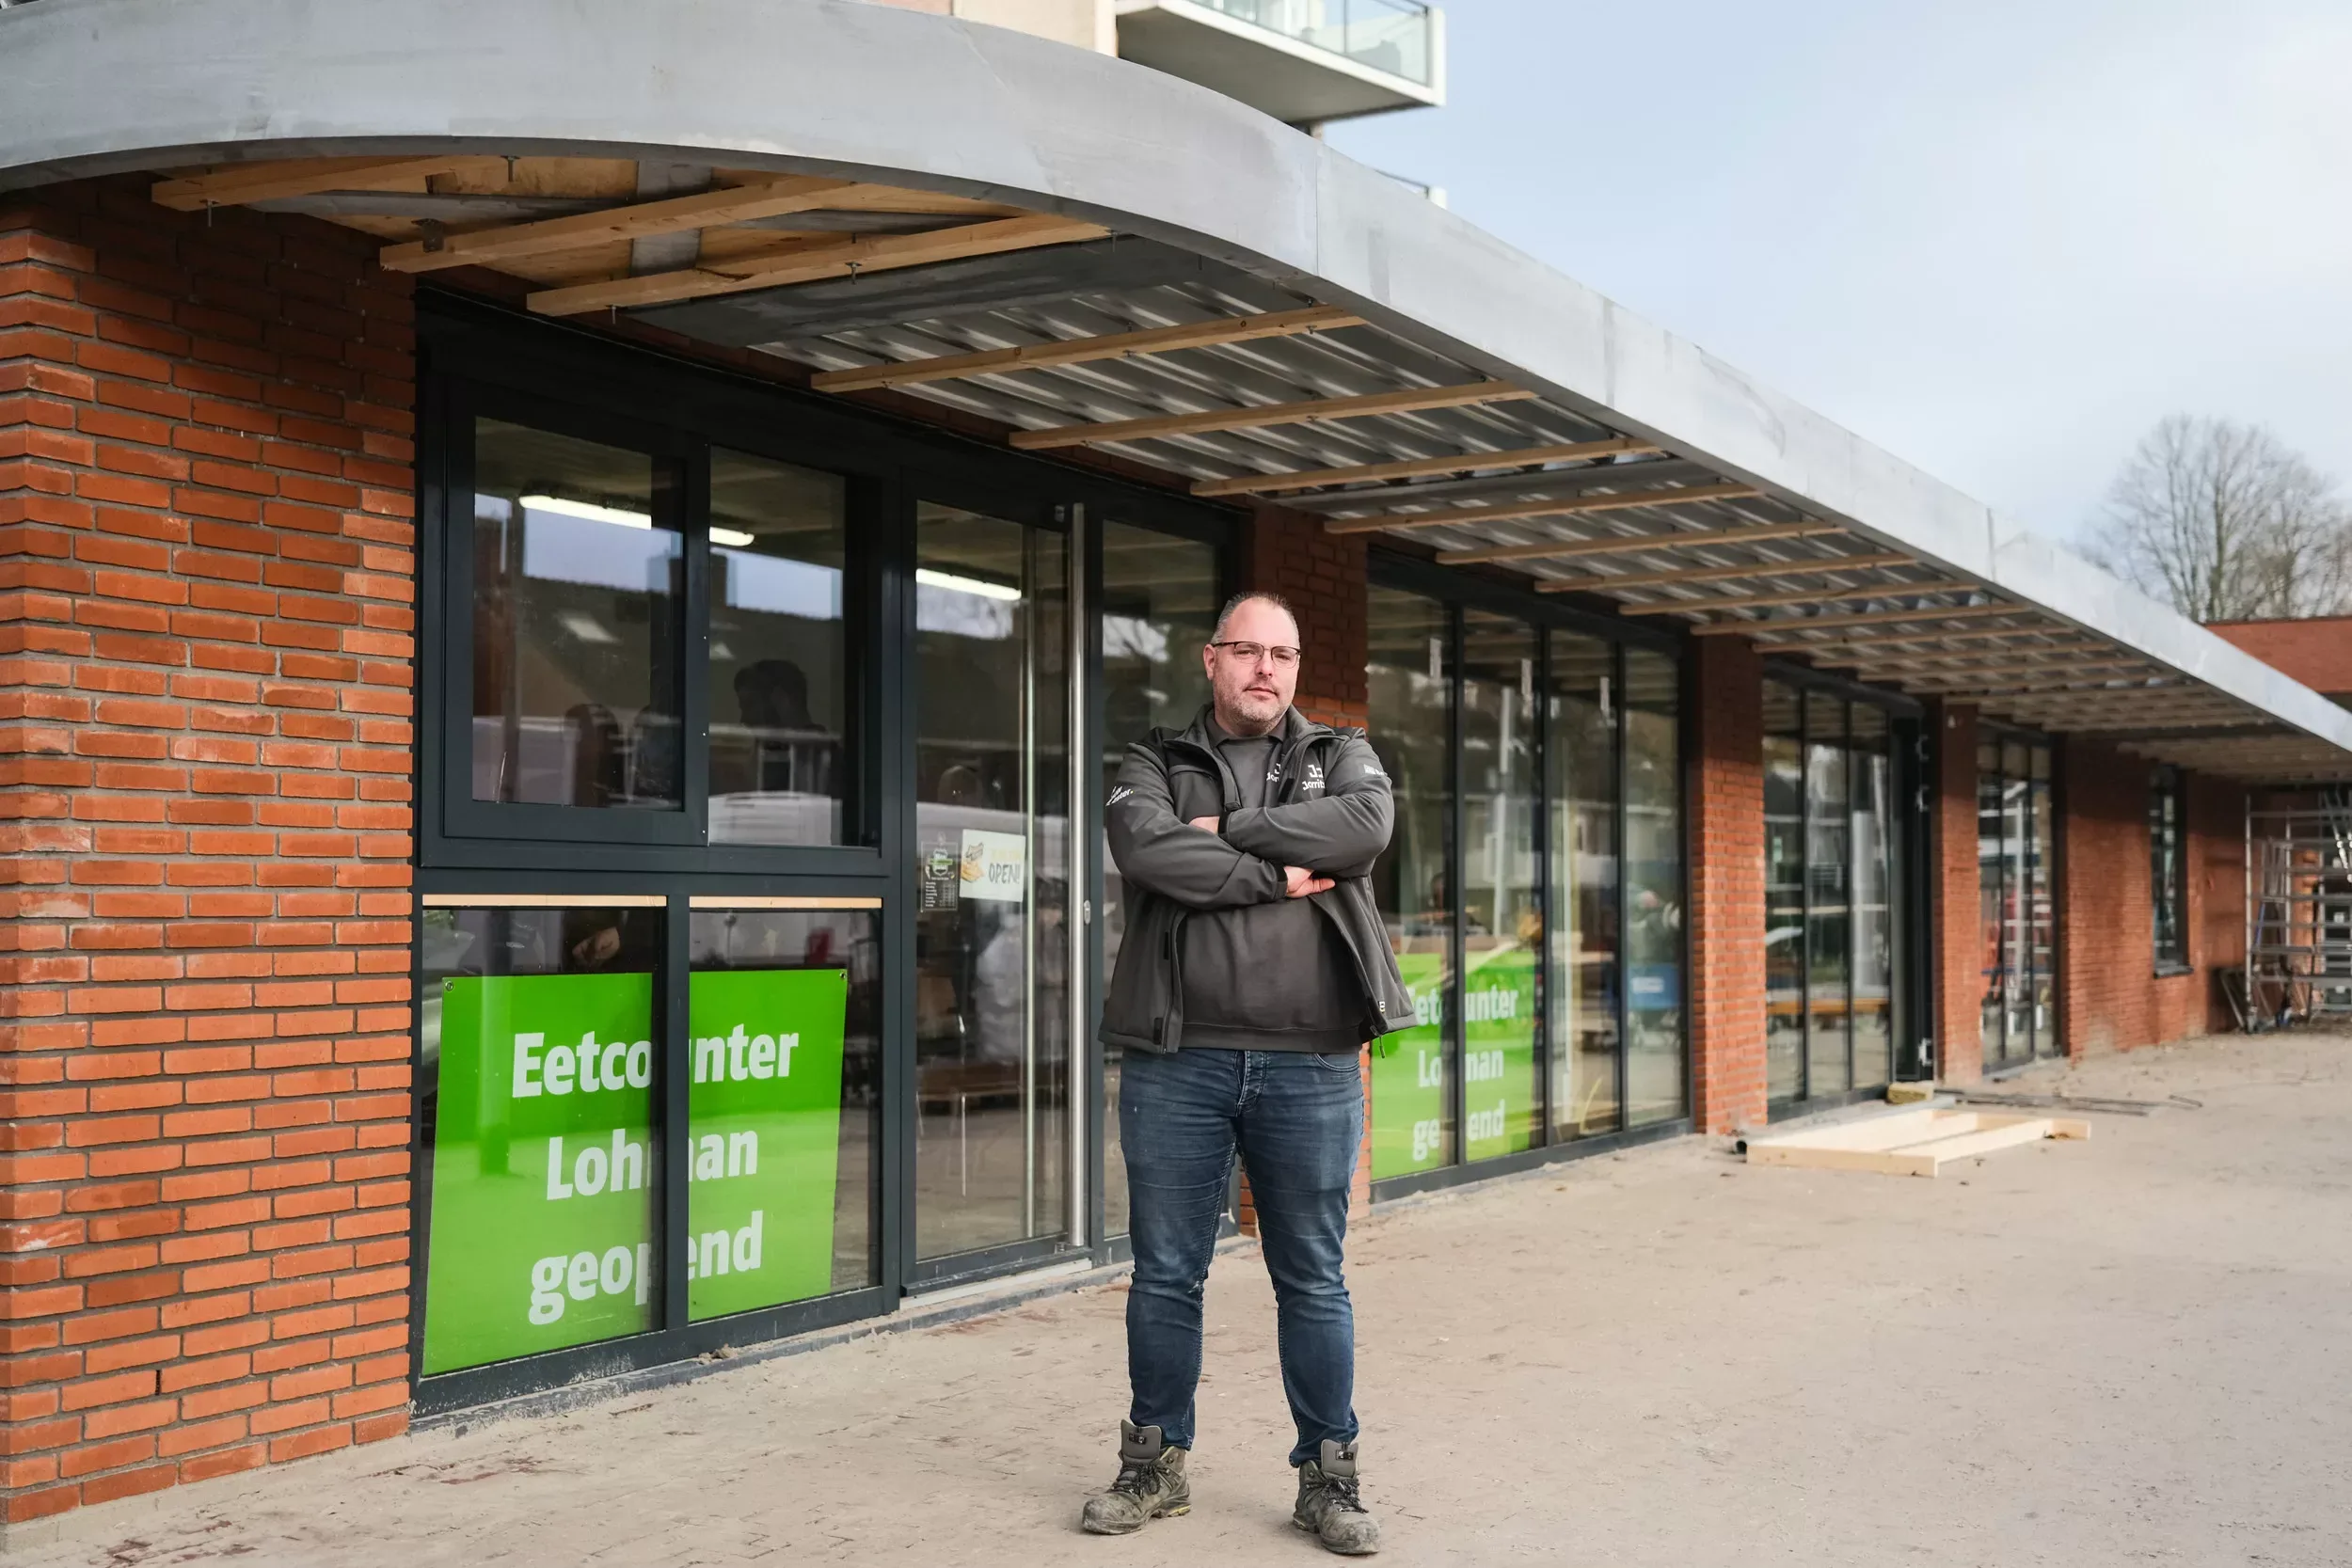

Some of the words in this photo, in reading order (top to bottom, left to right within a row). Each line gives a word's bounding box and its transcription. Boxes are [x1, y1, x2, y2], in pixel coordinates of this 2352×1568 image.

[989, 863, 1021, 884] OPEN!
[512, 1023, 800, 1098] Eetconter
[1418, 1049, 1504, 1087] Loman
[1412, 1098, 1505, 1161] geend
[546, 1128, 758, 1200] Lohan
